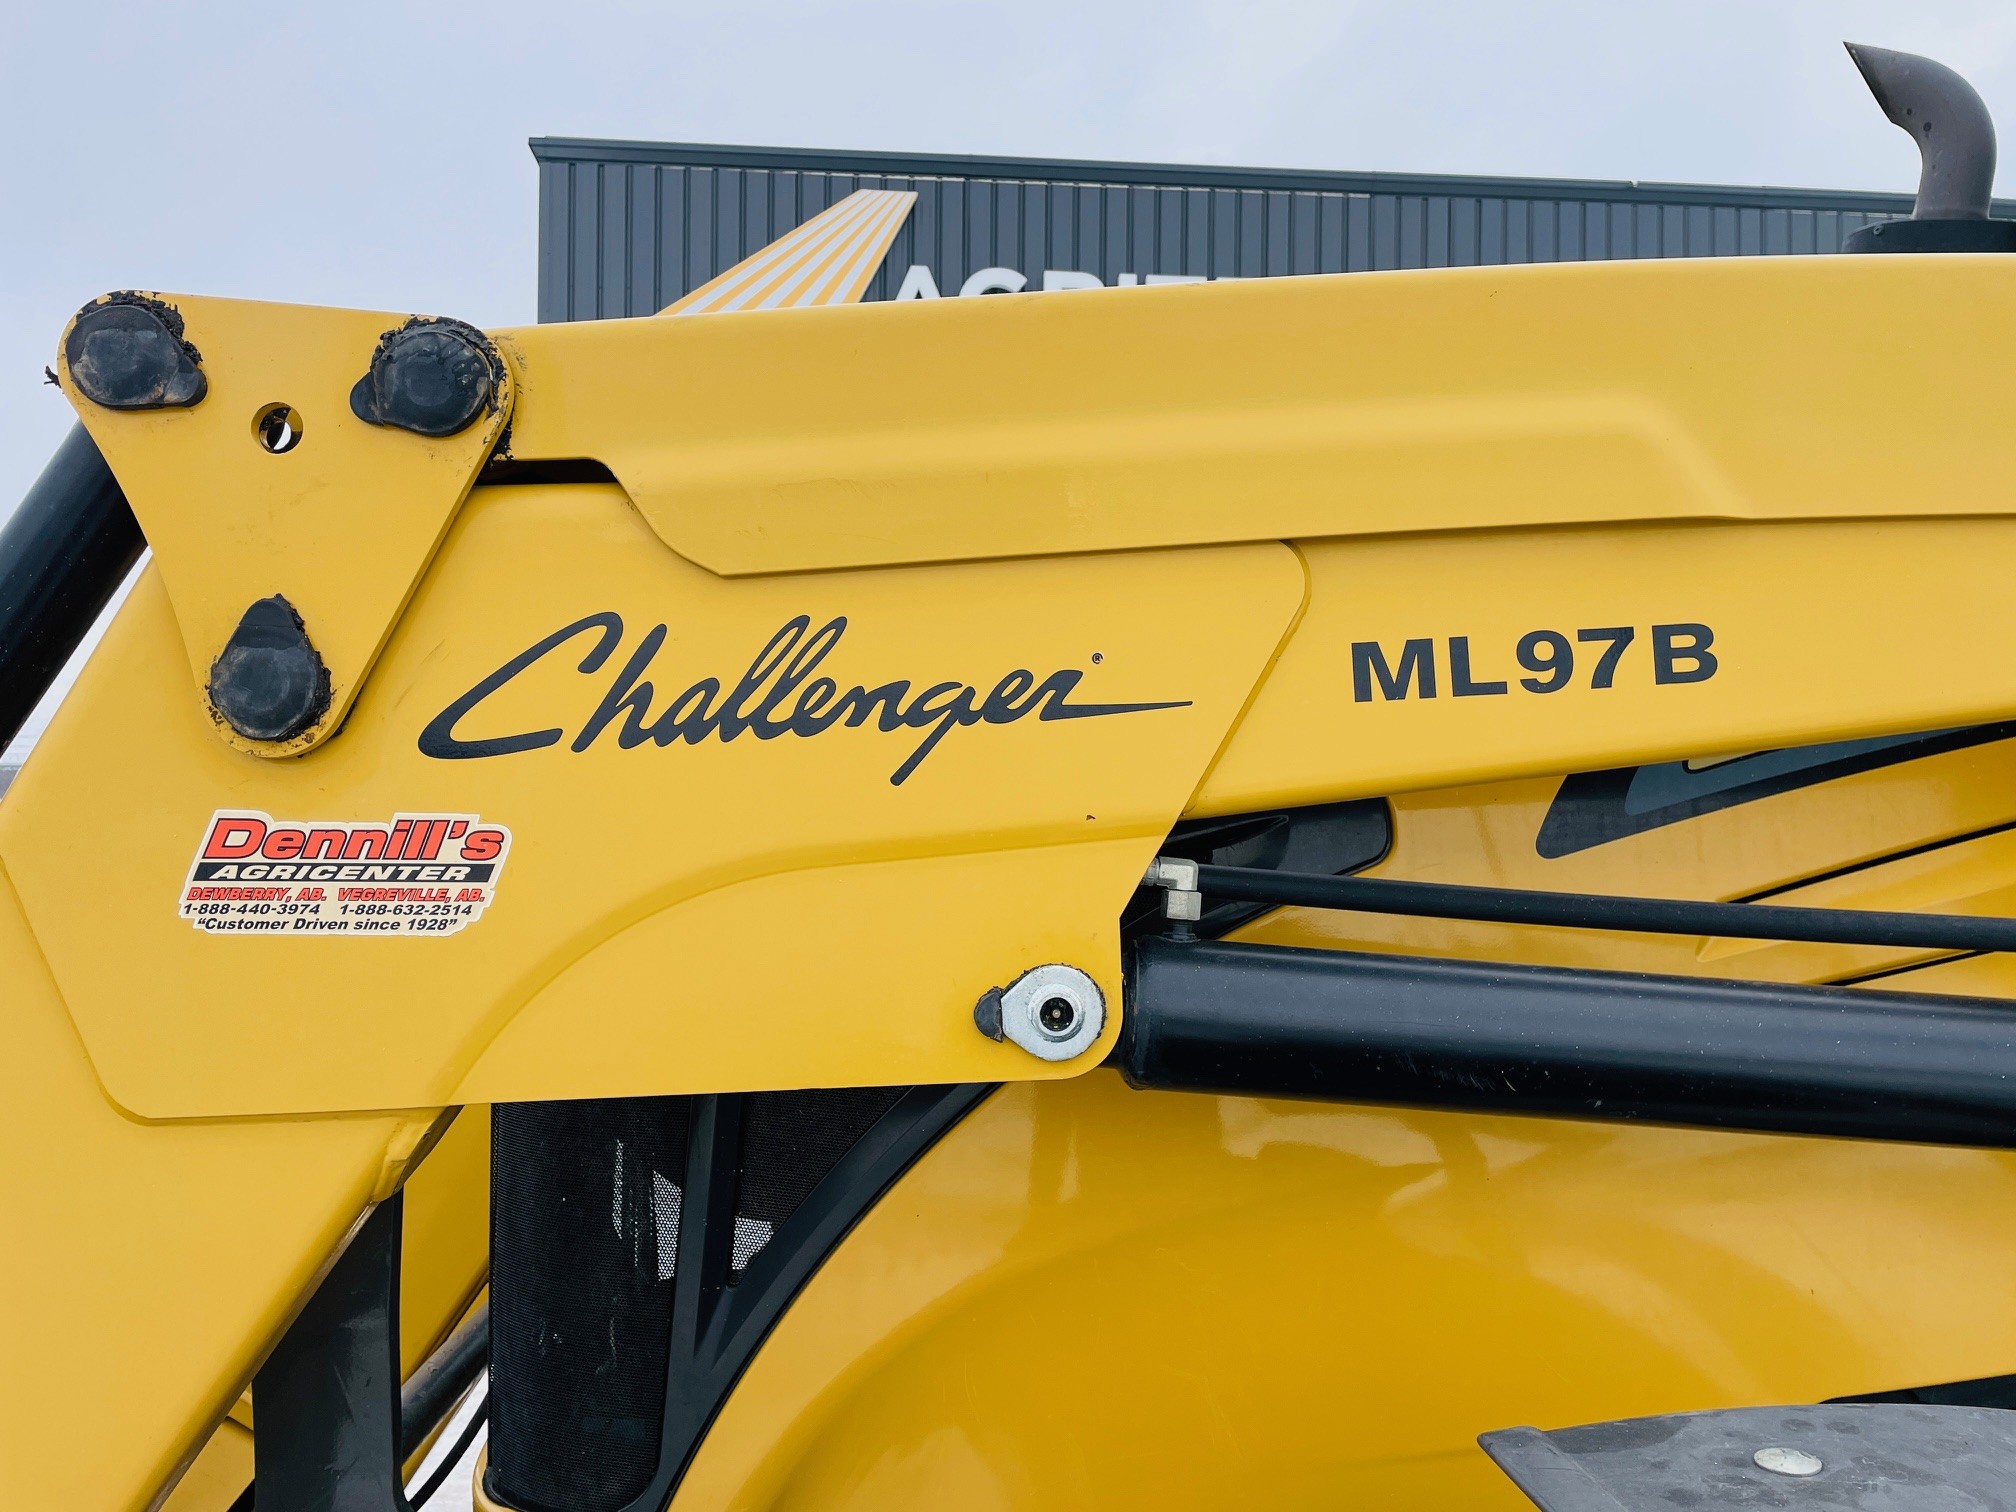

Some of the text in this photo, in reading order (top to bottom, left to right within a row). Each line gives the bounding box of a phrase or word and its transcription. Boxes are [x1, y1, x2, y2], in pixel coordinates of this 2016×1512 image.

[1351, 623, 1718, 703] ML97B
[418, 611, 1193, 786] Challenger
[201, 817, 505, 861] Dennill's
[209, 864, 471, 882] AGRICENTER
[187, 887, 485, 904] DEWBERRY, AB. VEGREVILLE, AB.
[183, 903, 472, 916] 1-888-440-3974 1-888-632-2514
[292, 918, 349, 930] Driven
[353, 918, 400, 930] since
